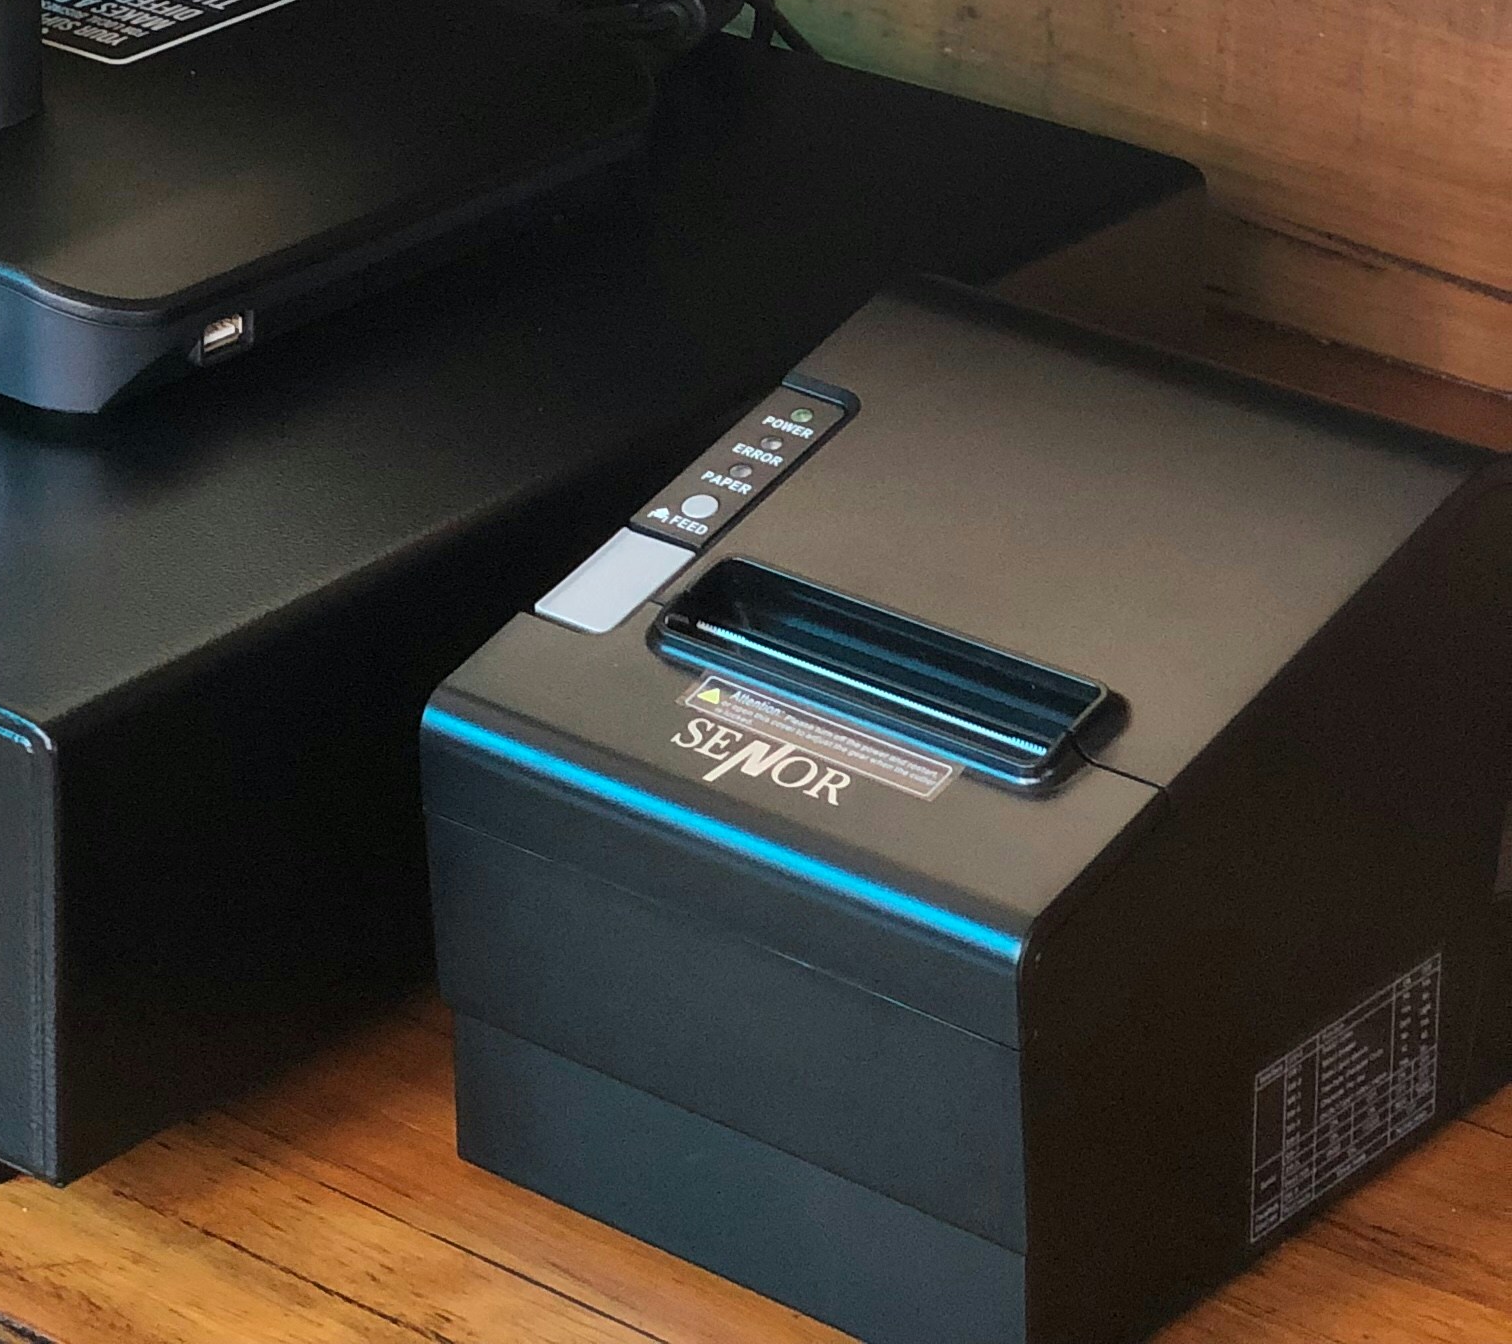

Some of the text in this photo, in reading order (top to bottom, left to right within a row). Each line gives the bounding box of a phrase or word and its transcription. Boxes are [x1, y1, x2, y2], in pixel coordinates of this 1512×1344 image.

[91, 3, 177, 31] MAKES
[74, 26, 128, 46] YOUR
[762, 415, 814, 439] POWER
[732, 443, 783, 467] ERROR
[701, 470, 753, 495] PAPER
[669, 515, 709, 537] FEED
[729, 691, 785, 717] Attention:
[670, 715, 853, 808] SENOR
